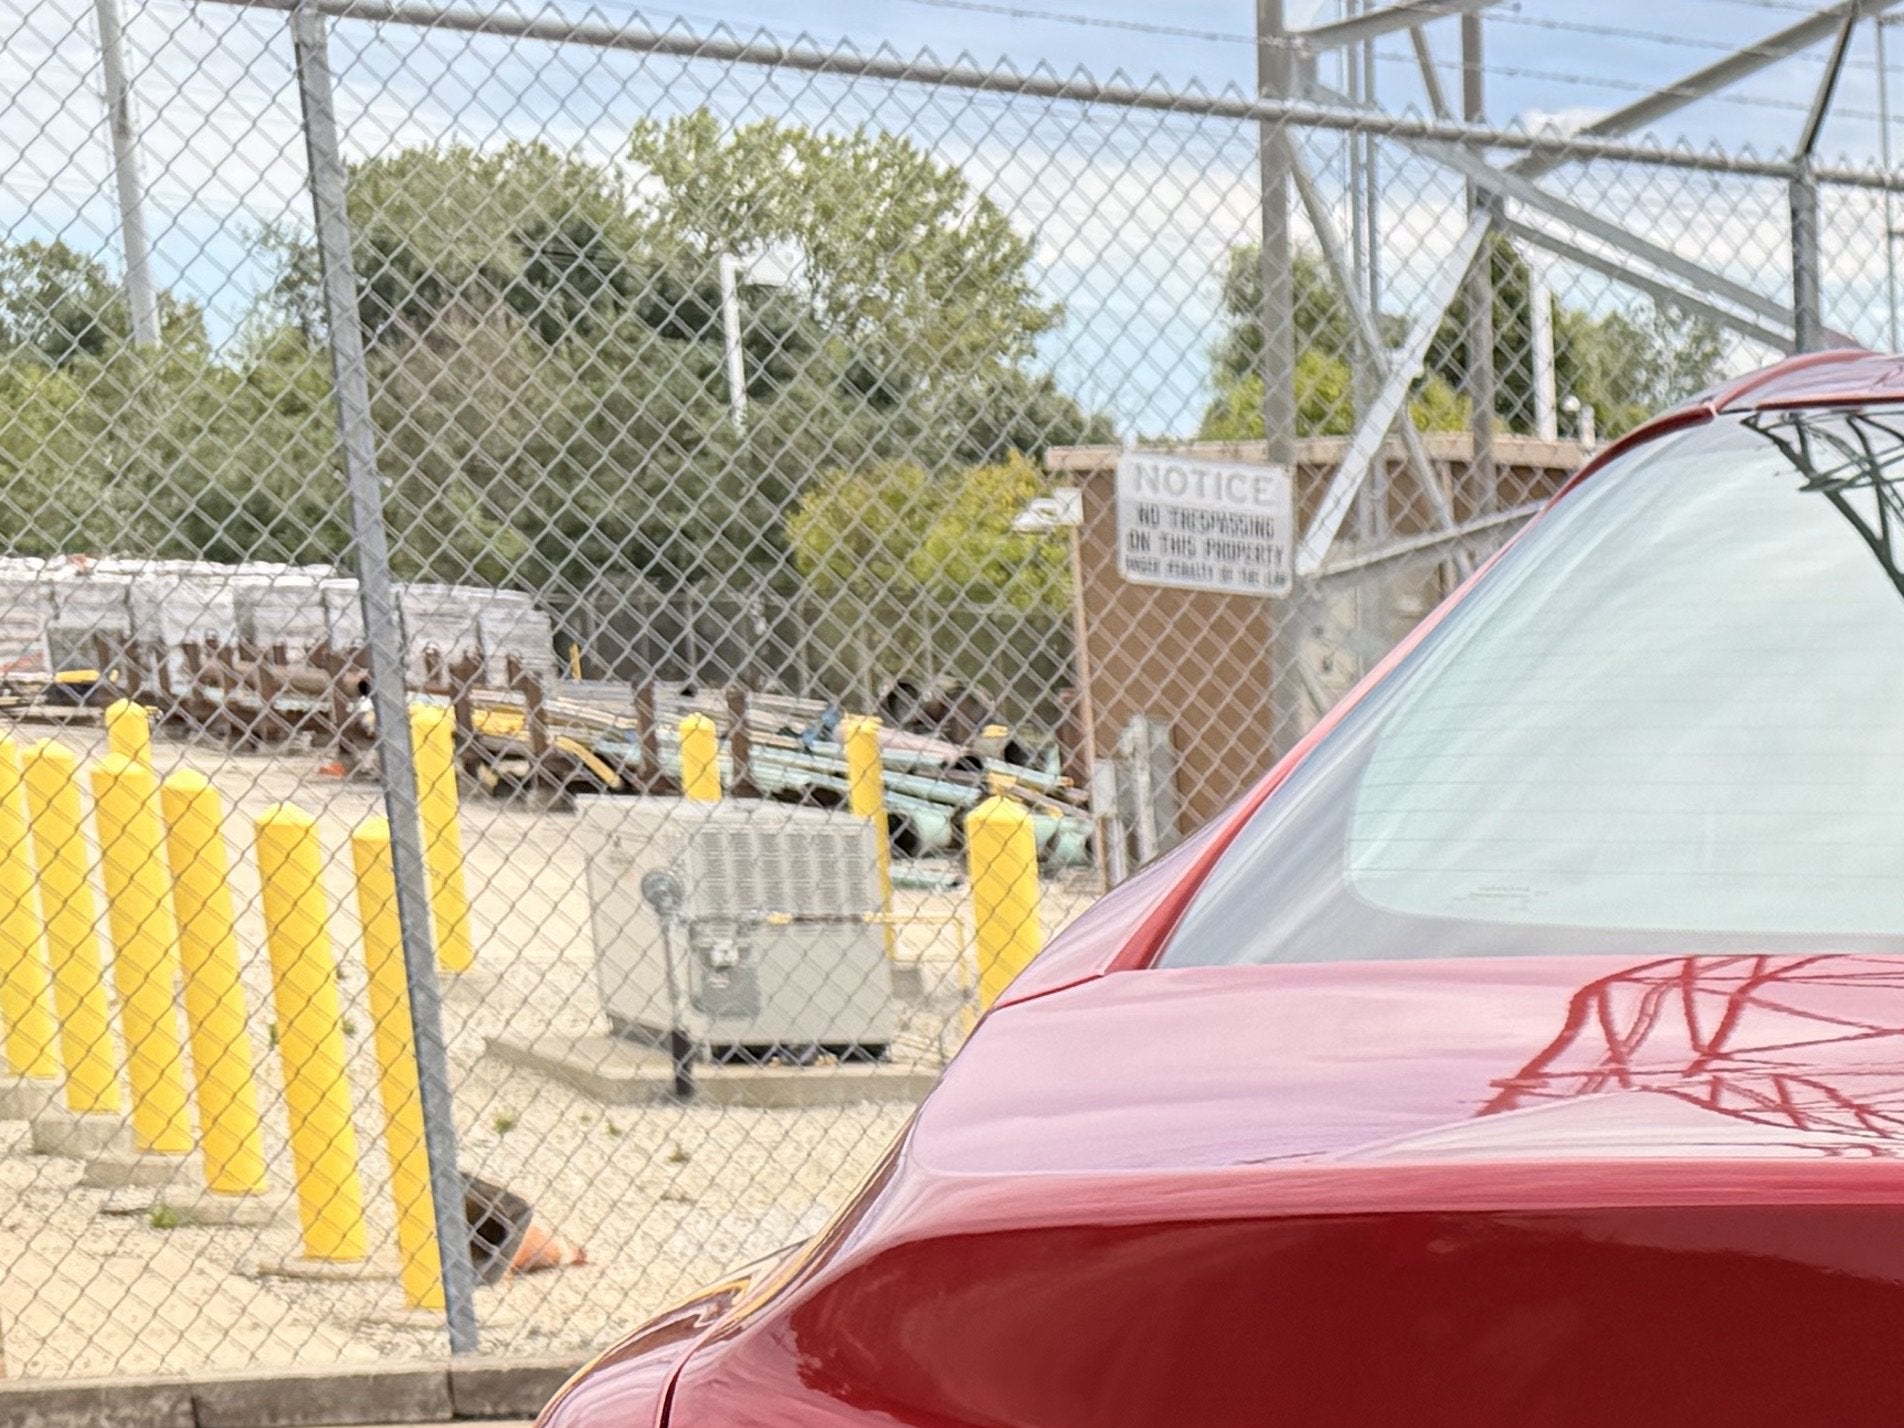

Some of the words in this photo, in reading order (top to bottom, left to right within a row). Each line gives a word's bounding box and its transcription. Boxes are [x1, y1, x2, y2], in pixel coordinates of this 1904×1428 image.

[1134, 463, 1276, 507] NOTICE
[1137, 502, 1161, 528] NO
[1168, 507, 1275, 539] TRESPASSING
[1128, 529, 1151, 553] ON
[1159, 532, 1197, 557] THIS
[1205, 538, 1284, 565] PROPERTY
